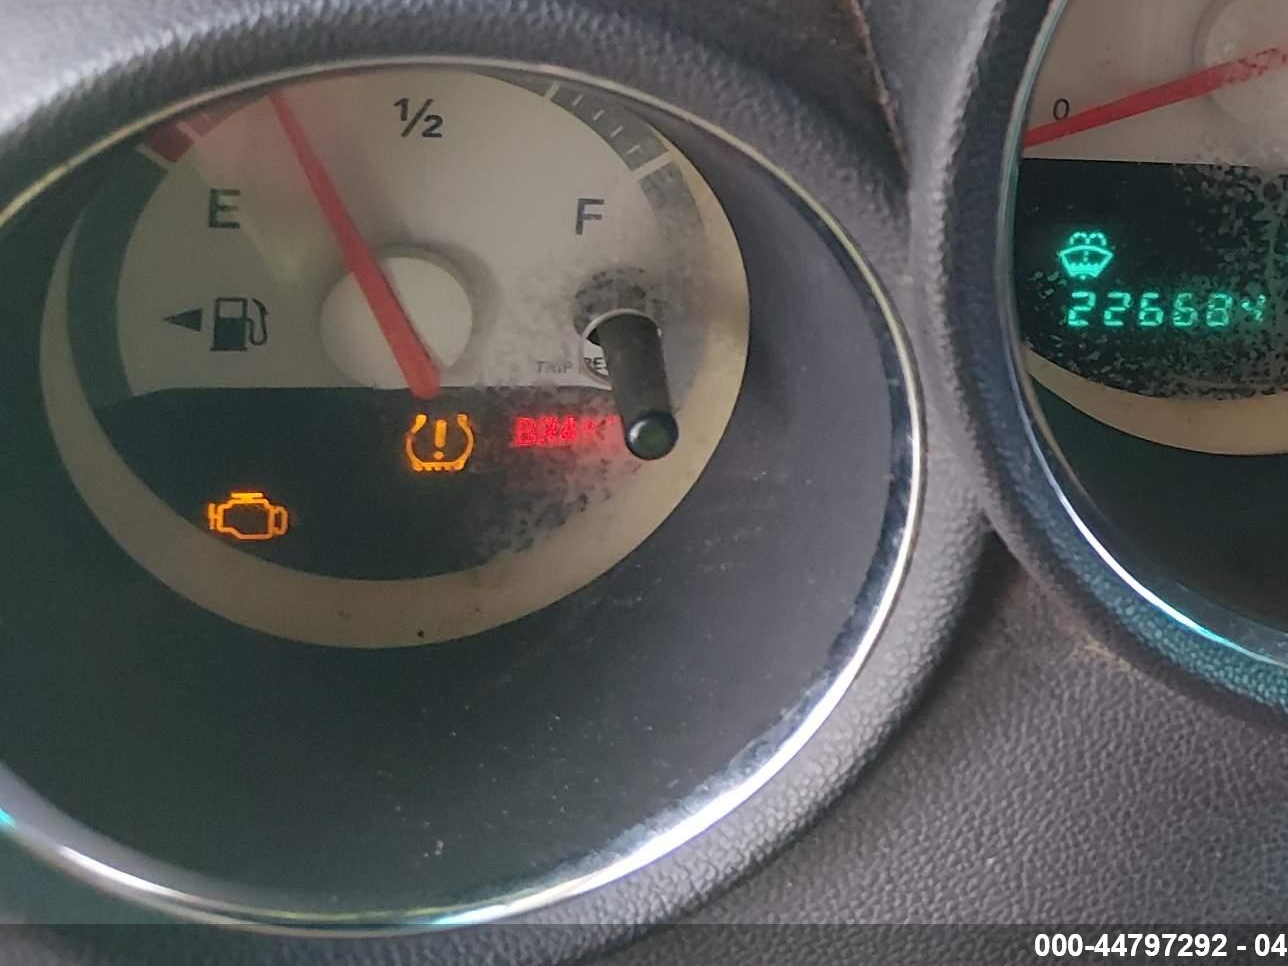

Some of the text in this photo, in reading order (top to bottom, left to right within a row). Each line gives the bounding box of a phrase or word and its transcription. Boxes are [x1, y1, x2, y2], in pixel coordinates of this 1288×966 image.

[1053, 98, 1070, 122] 0
[207, 188, 241, 230] E
[576, 198, 605, 235] F
[1067, 291, 1267, 328] 226684
